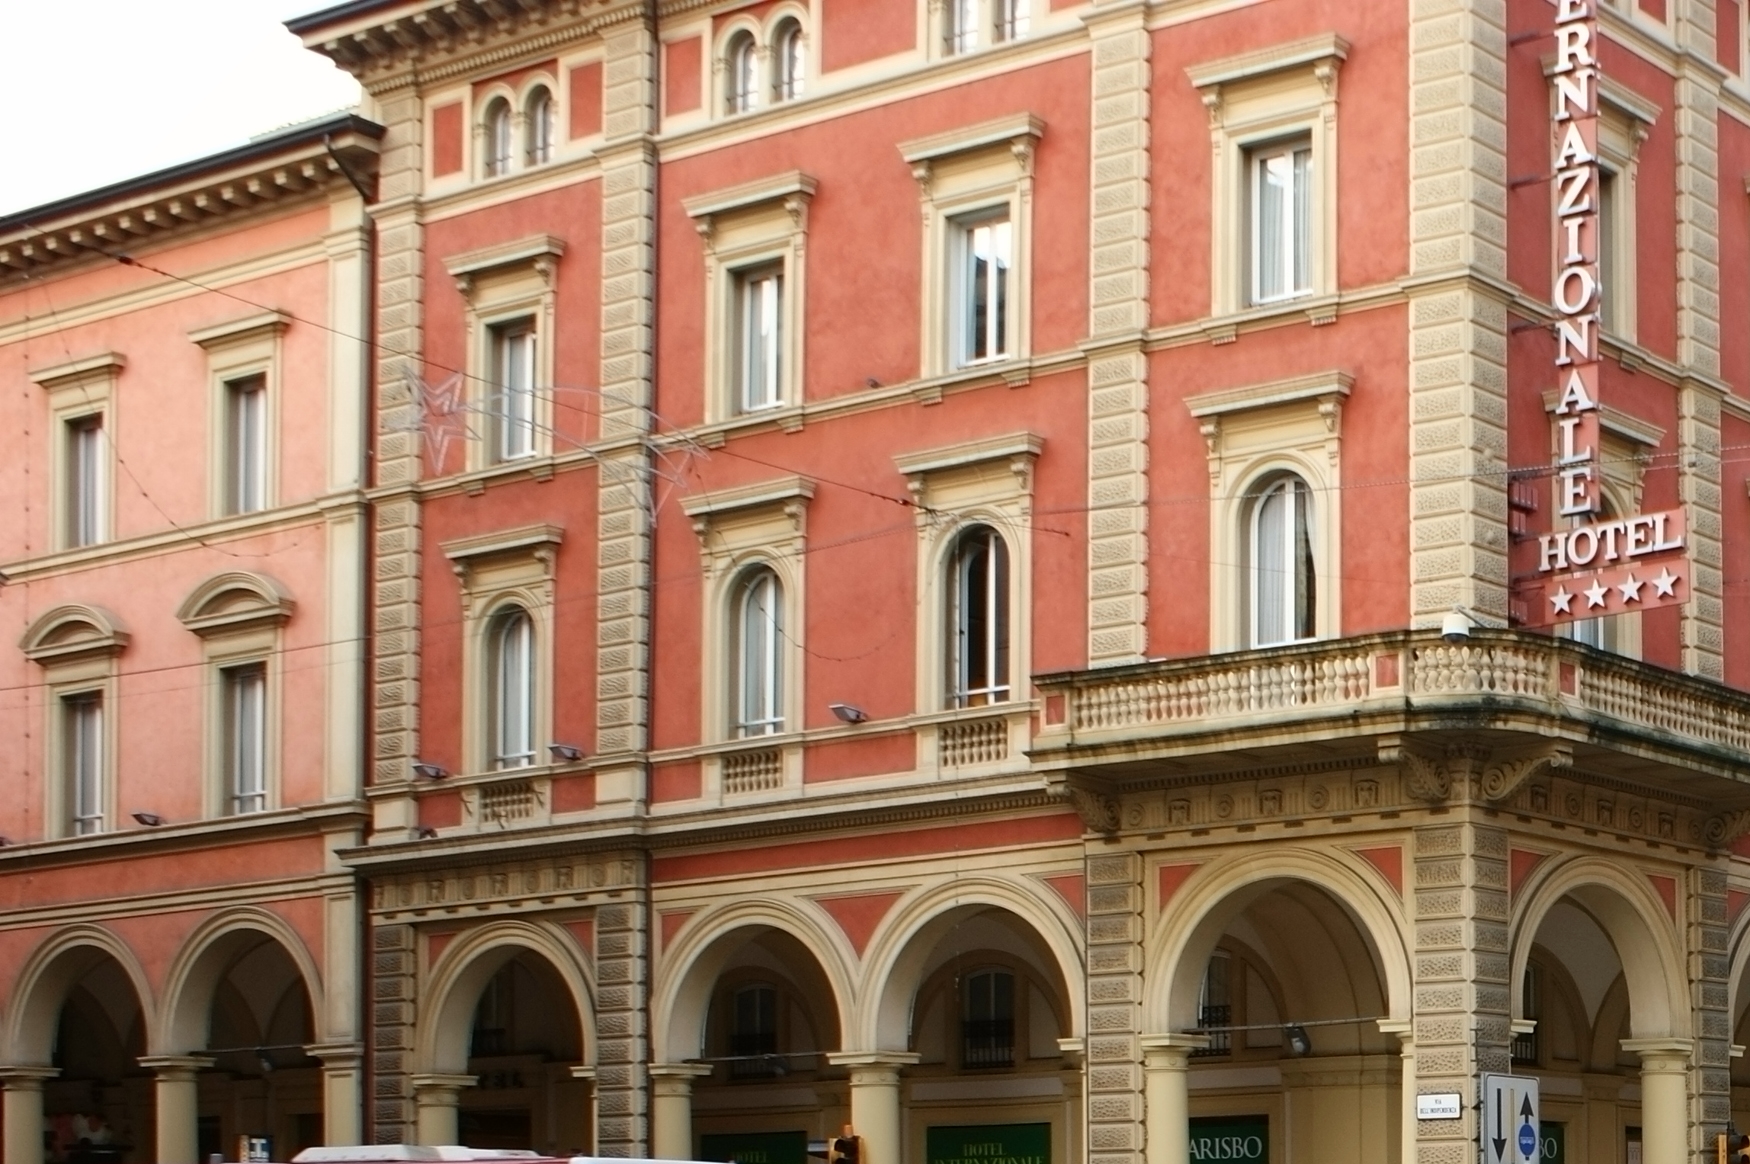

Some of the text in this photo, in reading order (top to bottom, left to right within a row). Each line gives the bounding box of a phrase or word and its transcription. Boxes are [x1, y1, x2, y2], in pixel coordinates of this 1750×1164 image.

[1538, 512, 1684, 571] HOTEL
[963, 1143, 1007, 1157] HOTEL
[1189, 1135, 1263, 1160] ARISBO
